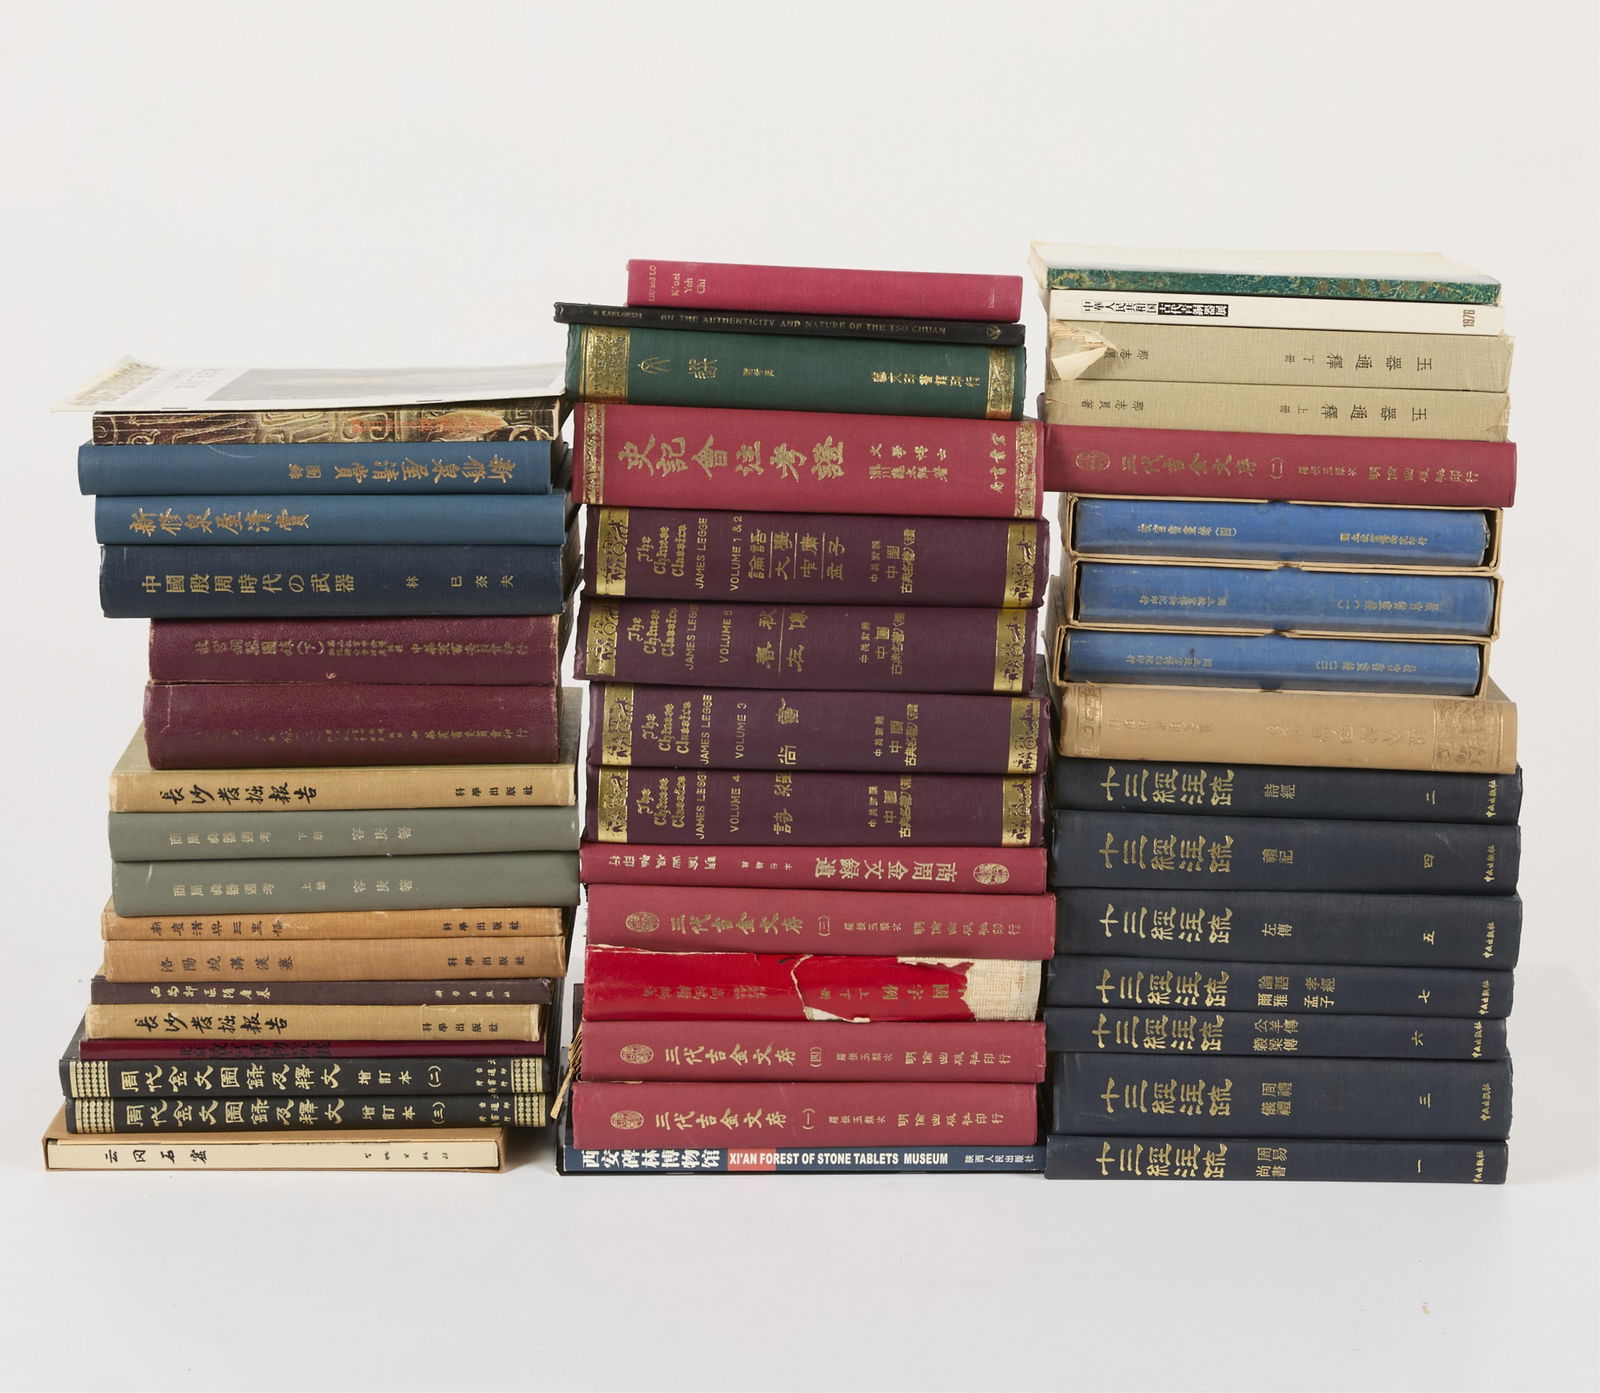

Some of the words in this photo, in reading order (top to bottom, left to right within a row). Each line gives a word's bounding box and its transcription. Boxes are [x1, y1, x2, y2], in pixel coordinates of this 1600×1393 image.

[660, 313, 675, 322] ON
[679, 314, 699, 323] THE
[703, 316, 775, 327] AUTHENTICITY
[780, 320, 801, 329] AND
[805, 320, 846, 330] NATURE
[850, 322, 863, 331] OF
[866, 323, 886, 332] THE
[911, 325, 946, 335] CHUAN
[1462, 308, 1475, 328] 1976
[1326, 352, 1433, 374] 玉器通釋
[1321, 401, 1428, 423] 玉器通釋
[334, 453, 516, 485] 新修泉屋清賞
[617, 433, 846, 482] 史記會注考證
[1121, 453, 1258, 478] 三代吉金文存
[129, 507, 311, 536] 新修泉屋清賞
[697, 518, 708, 551] LEGGE
[637, 536, 653, 562] The
[653, 526, 670, 575] Chinese
[671, 523, 687, 578] Classics
[747, 528, 767, 580] 論語
[774, 531, 793, 582] 大學
[801, 532, 819, 579] 中庸
[827, 535, 845, 580] 孟子
[885, 545, 900, 579] 中國
[695, 554, 706, 590] JAMES
[730, 545, 742, 592] VOLUME
[141, 573, 356, 595] 中國殷周時代の武器
[627, 616, 644, 642] The
[643, 608, 661, 655] Chinese
[661, 607, 677, 657] Classics
[719, 618, 731, 664] VOLUME
[756, 609, 777, 670] 春秋
[875, 625, 890, 660] 中國
[685, 634, 696, 671] JAMES
[702, 693, 713, 729] LEGGE
[641, 713, 658, 739] The
[658, 703, 675, 752] Chinese
[675, 701, 691, 755] Classics
[735, 714, 746, 759] VOLUME
[777, 697, 799, 766] 尚書
[888, 719, 904, 754] 中國
[700, 732, 710, 766] JAMES
[454, 784, 534, 798] 科學出版社
[1101, 765, 1235, 807] 十三經注疏
[1264, 783, 1296, 799] 詩經
[1426, 790, 1436, 805] 二
[636, 787, 654, 814] The
[654, 777, 671, 826] Chinese
[671, 775, 686, 829] Classics
[730, 787, 741, 833] VOLUME
[773, 772, 794, 835] 詩經
[882, 789, 897, 824] 中國
[695, 804, 705, 840] JAMES
[1099, 831, 1234, 873] 十三經注疏
[1262, 848, 1294, 865] 禮記
[1424, 853, 1434, 869] 四
[442, 919, 520, 932] 科學出版社
[669, 911, 803, 937] 三代吉金文存
[1099, 903, 1232, 944] 十三經注疏
[1262, 923, 1293, 938] 左傳
[1423, 930, 1435, 945] 五
[448, 954, 526, 968] 科學出版社
[1096, 968, 1230, 1007] 十三經注疏
[1257, 975, 1290, 990] 論語
[1304, 977, 1336, 992] 孝經
[1303, 995, 1335, 1008] 孟子
[1417, 990, 1430, 1004] 七
[421, 1021, 500, 1034] 科學出版社
[1092, 1012, 1225, 1052] 十三經注疏
[1254, 1018, 1299, 1033] 公羊傳
[1411, 1030, 1424, 1045] 六
[665, 1046, 796, 1068] 三代吉金文存
[357, 1069, 413, 1087] 增訂本
[1261, 1081, 1293, 1097] 周禮
[1100, 1077, 1233, 1116] 十三經注疏
[1261, 1100, 1292, 1117] 儀禮
[1419, 1093, 1432, 1108] 三
[361, 1104, 417, 1122] 增訂本
[655, 1110, 788, 1132] 三代吉金文存
[581, 1149, 720, 1169] 西安碑林博物馆
[729, 1152, 758, 1166] XI'AN
[760, 1152, 800, 1166] FOREST
[802, 1153, 815, 1165] OF
[817, 1153, 851, 1165] STONE
[853, 1153, 899, 1166] TABLETS
[903, 1153, 949, 1166] MUSEUM
[1096, 1141, 1228, 1180] 十三經注疏
[1256, 1146, 1288, 1163] 周易
[1417, 1160, 1423, 1174] 一
[1256, 1163, 1287, 1179] 尚書
